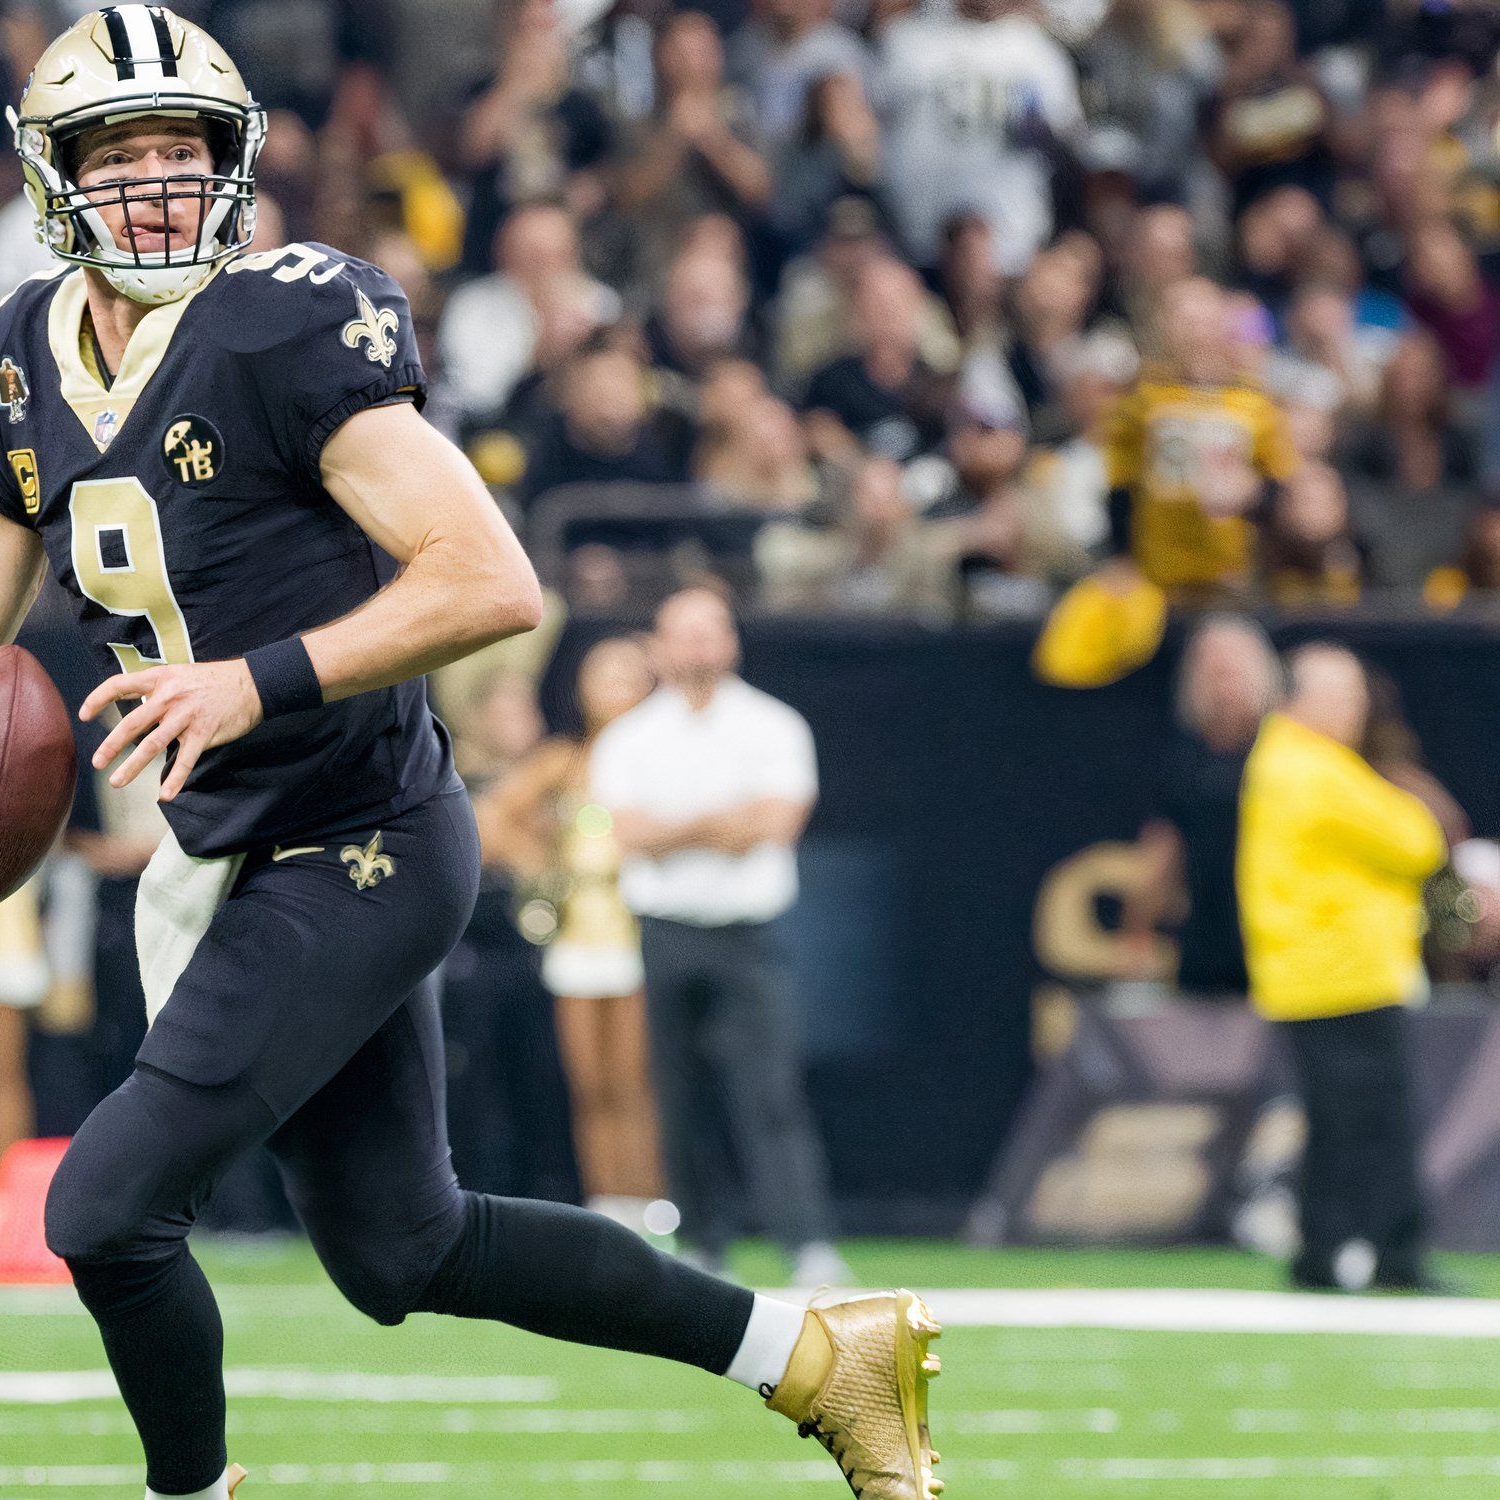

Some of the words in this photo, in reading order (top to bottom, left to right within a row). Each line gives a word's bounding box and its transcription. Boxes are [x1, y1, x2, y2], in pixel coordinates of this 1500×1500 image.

[12, 454, 36, 497] C
[173, 455, 214, 483] TB
[68, 475, 196, 674] 9
